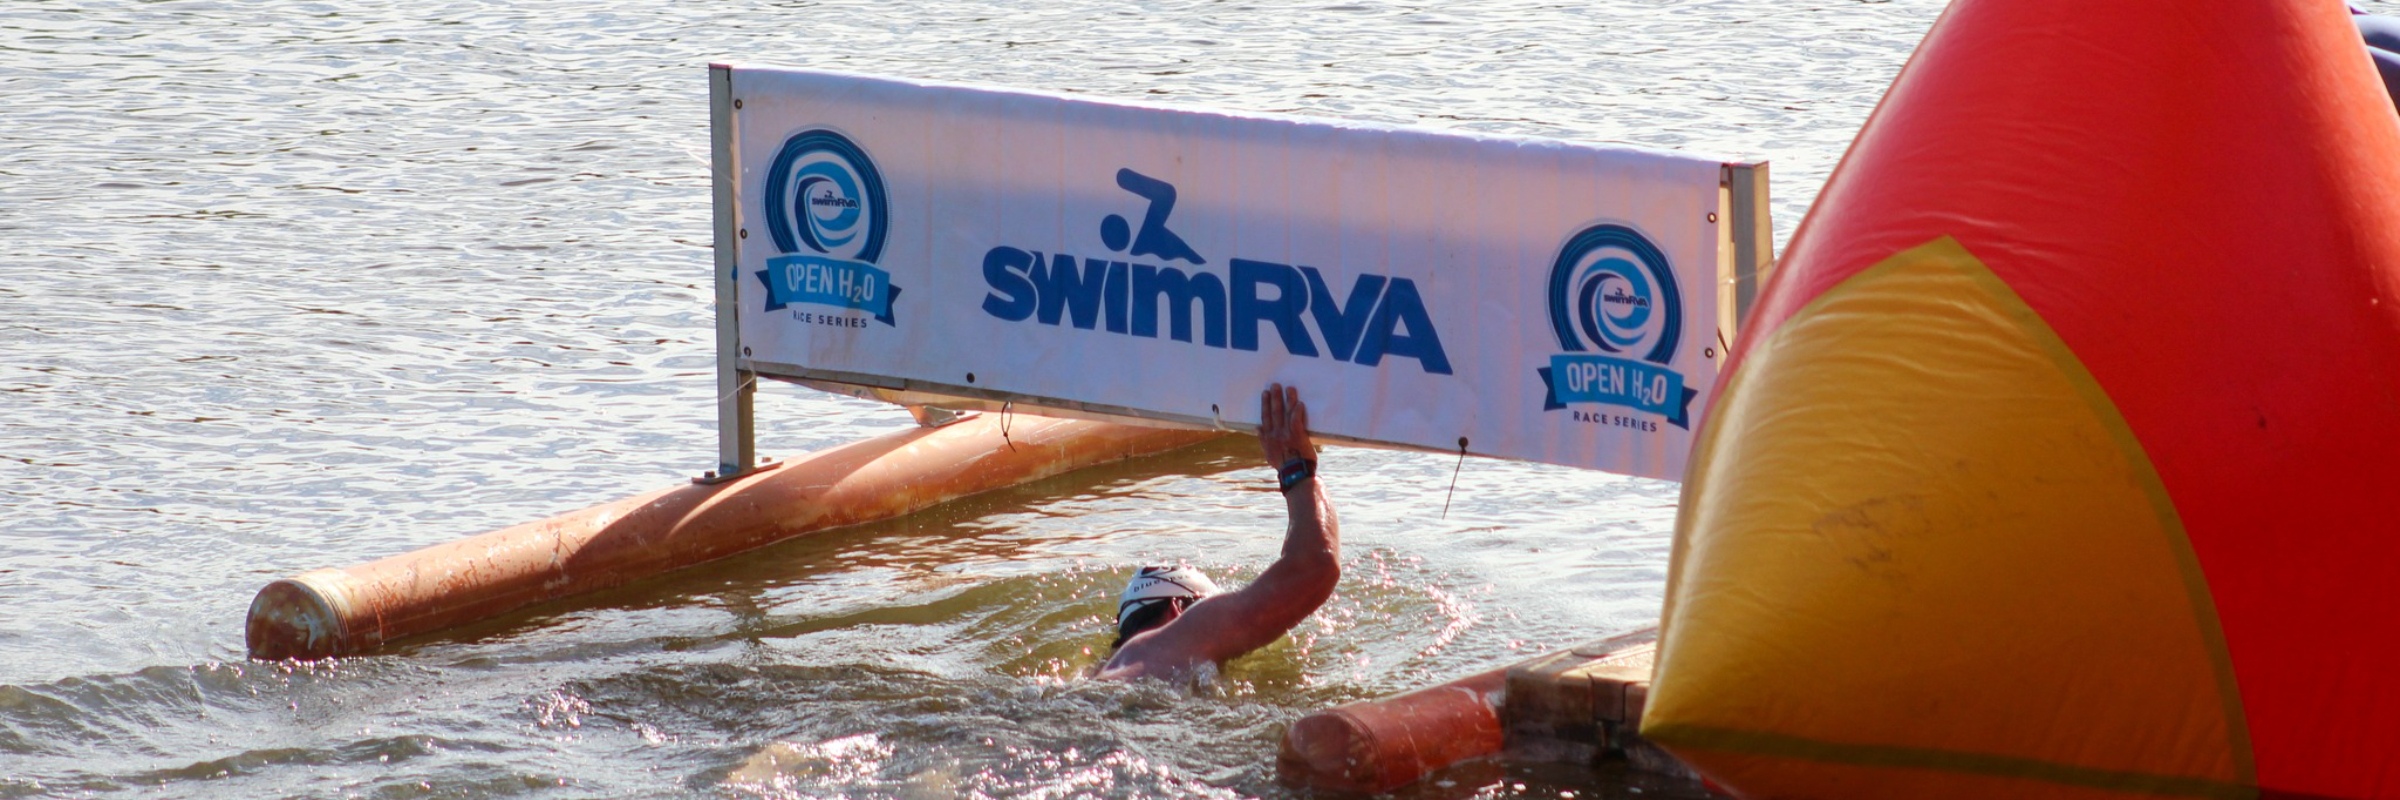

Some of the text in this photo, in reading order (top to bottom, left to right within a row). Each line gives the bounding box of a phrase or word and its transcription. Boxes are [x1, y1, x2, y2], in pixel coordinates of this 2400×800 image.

[785, 263, 875, 303] OPEN H2O
[818, 314, 867, 329] SERIES
[1566, 362, 1668, 406] OPEN H2O
[1573, 411, 1657, 432] RACE SERIES
